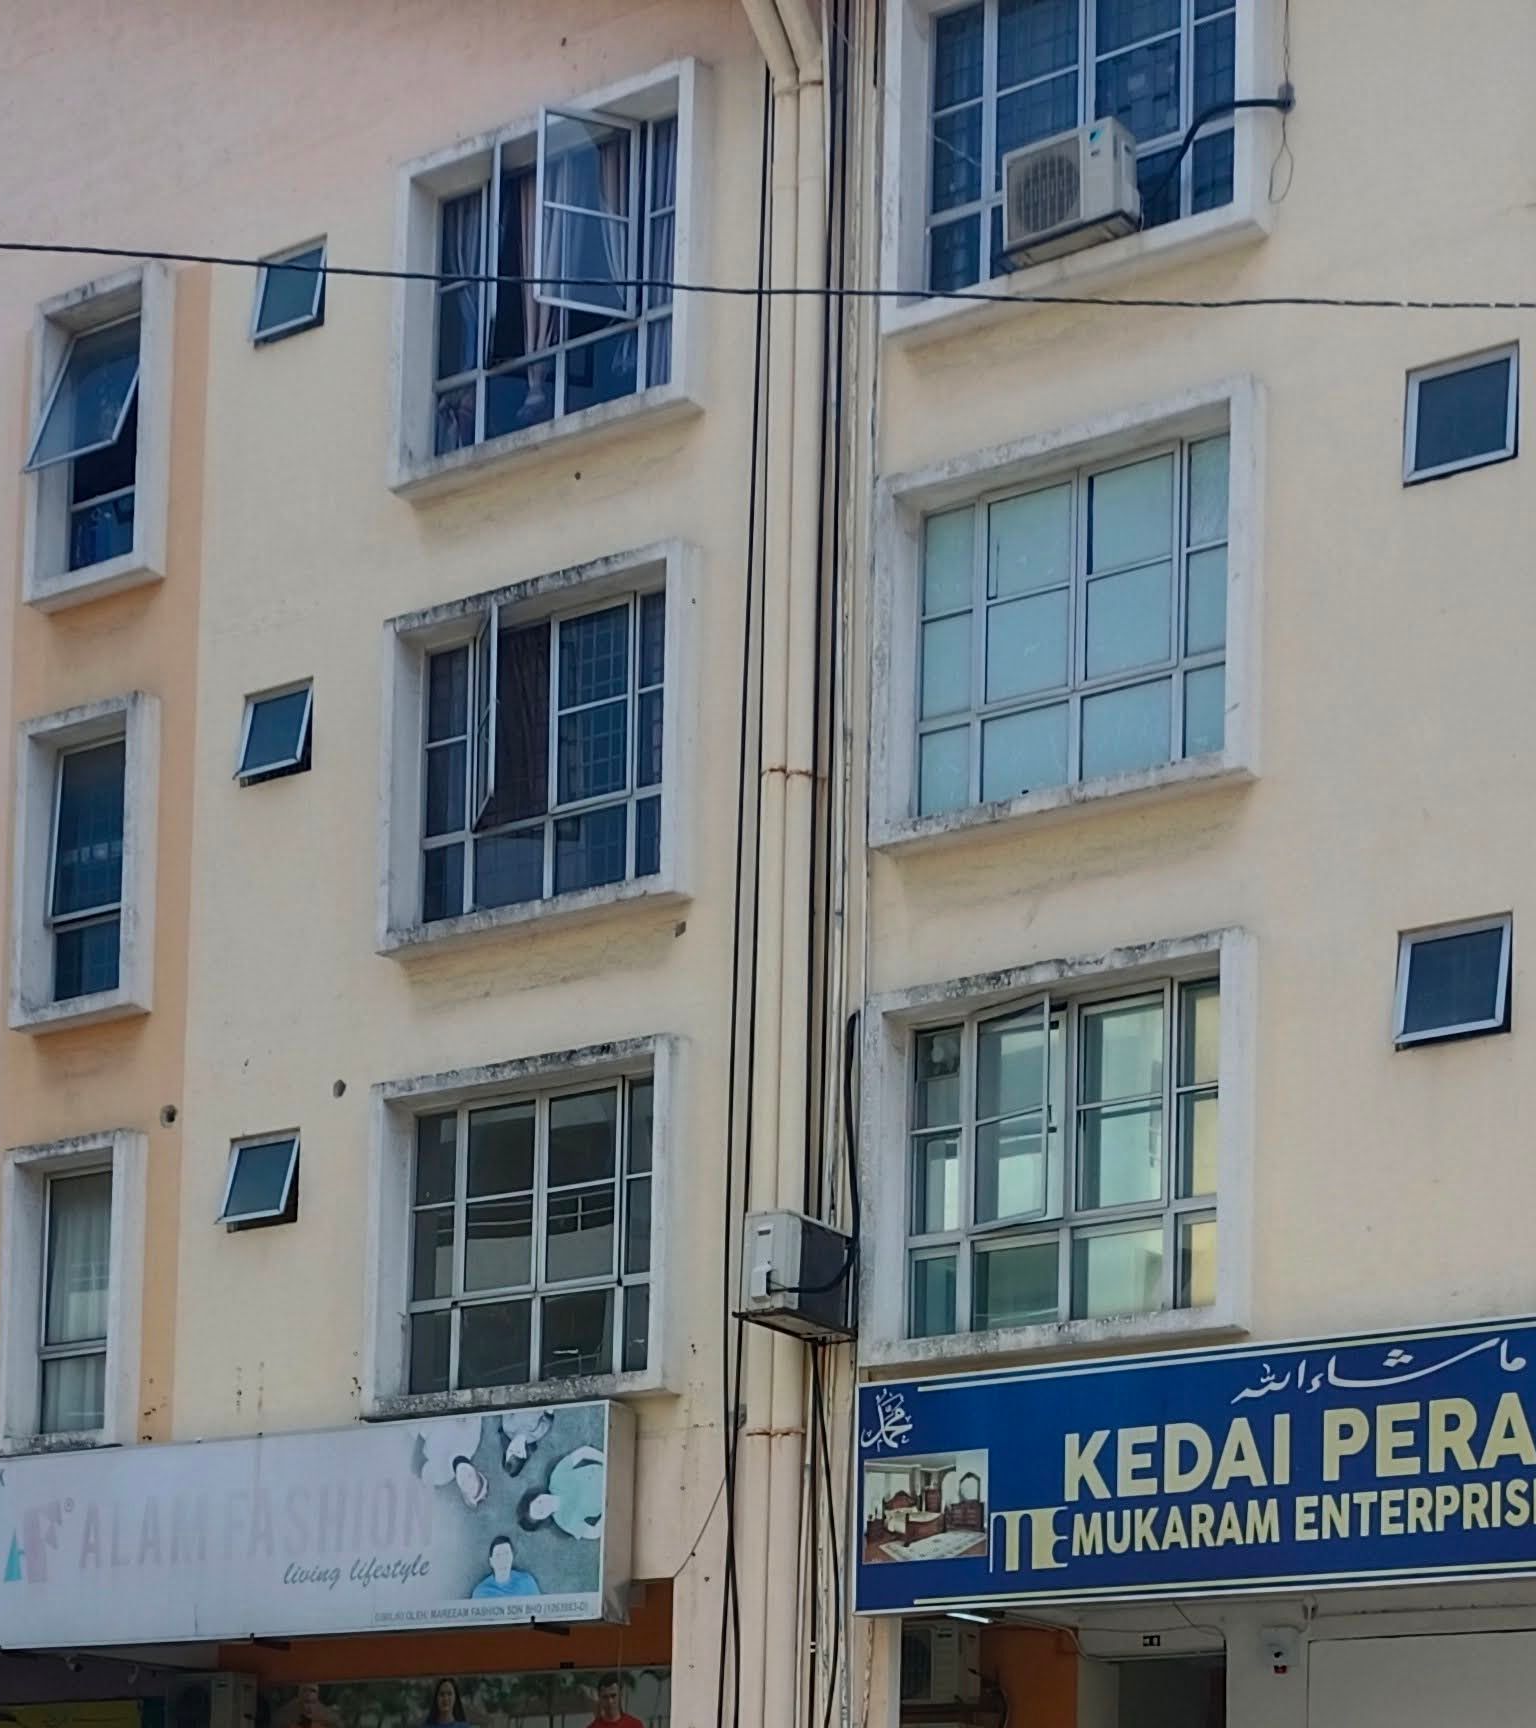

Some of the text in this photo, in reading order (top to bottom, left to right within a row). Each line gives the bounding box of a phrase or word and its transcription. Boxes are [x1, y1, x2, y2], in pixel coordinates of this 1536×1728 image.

[1063, 1412, 1291, 1503] KEDAI
[80, 1477, 434, 1571] ALAM FASHION
[1071, 1500, 1280, 1557] MUKARAM
[283, 1554, 431, 1591] living lifestyle
